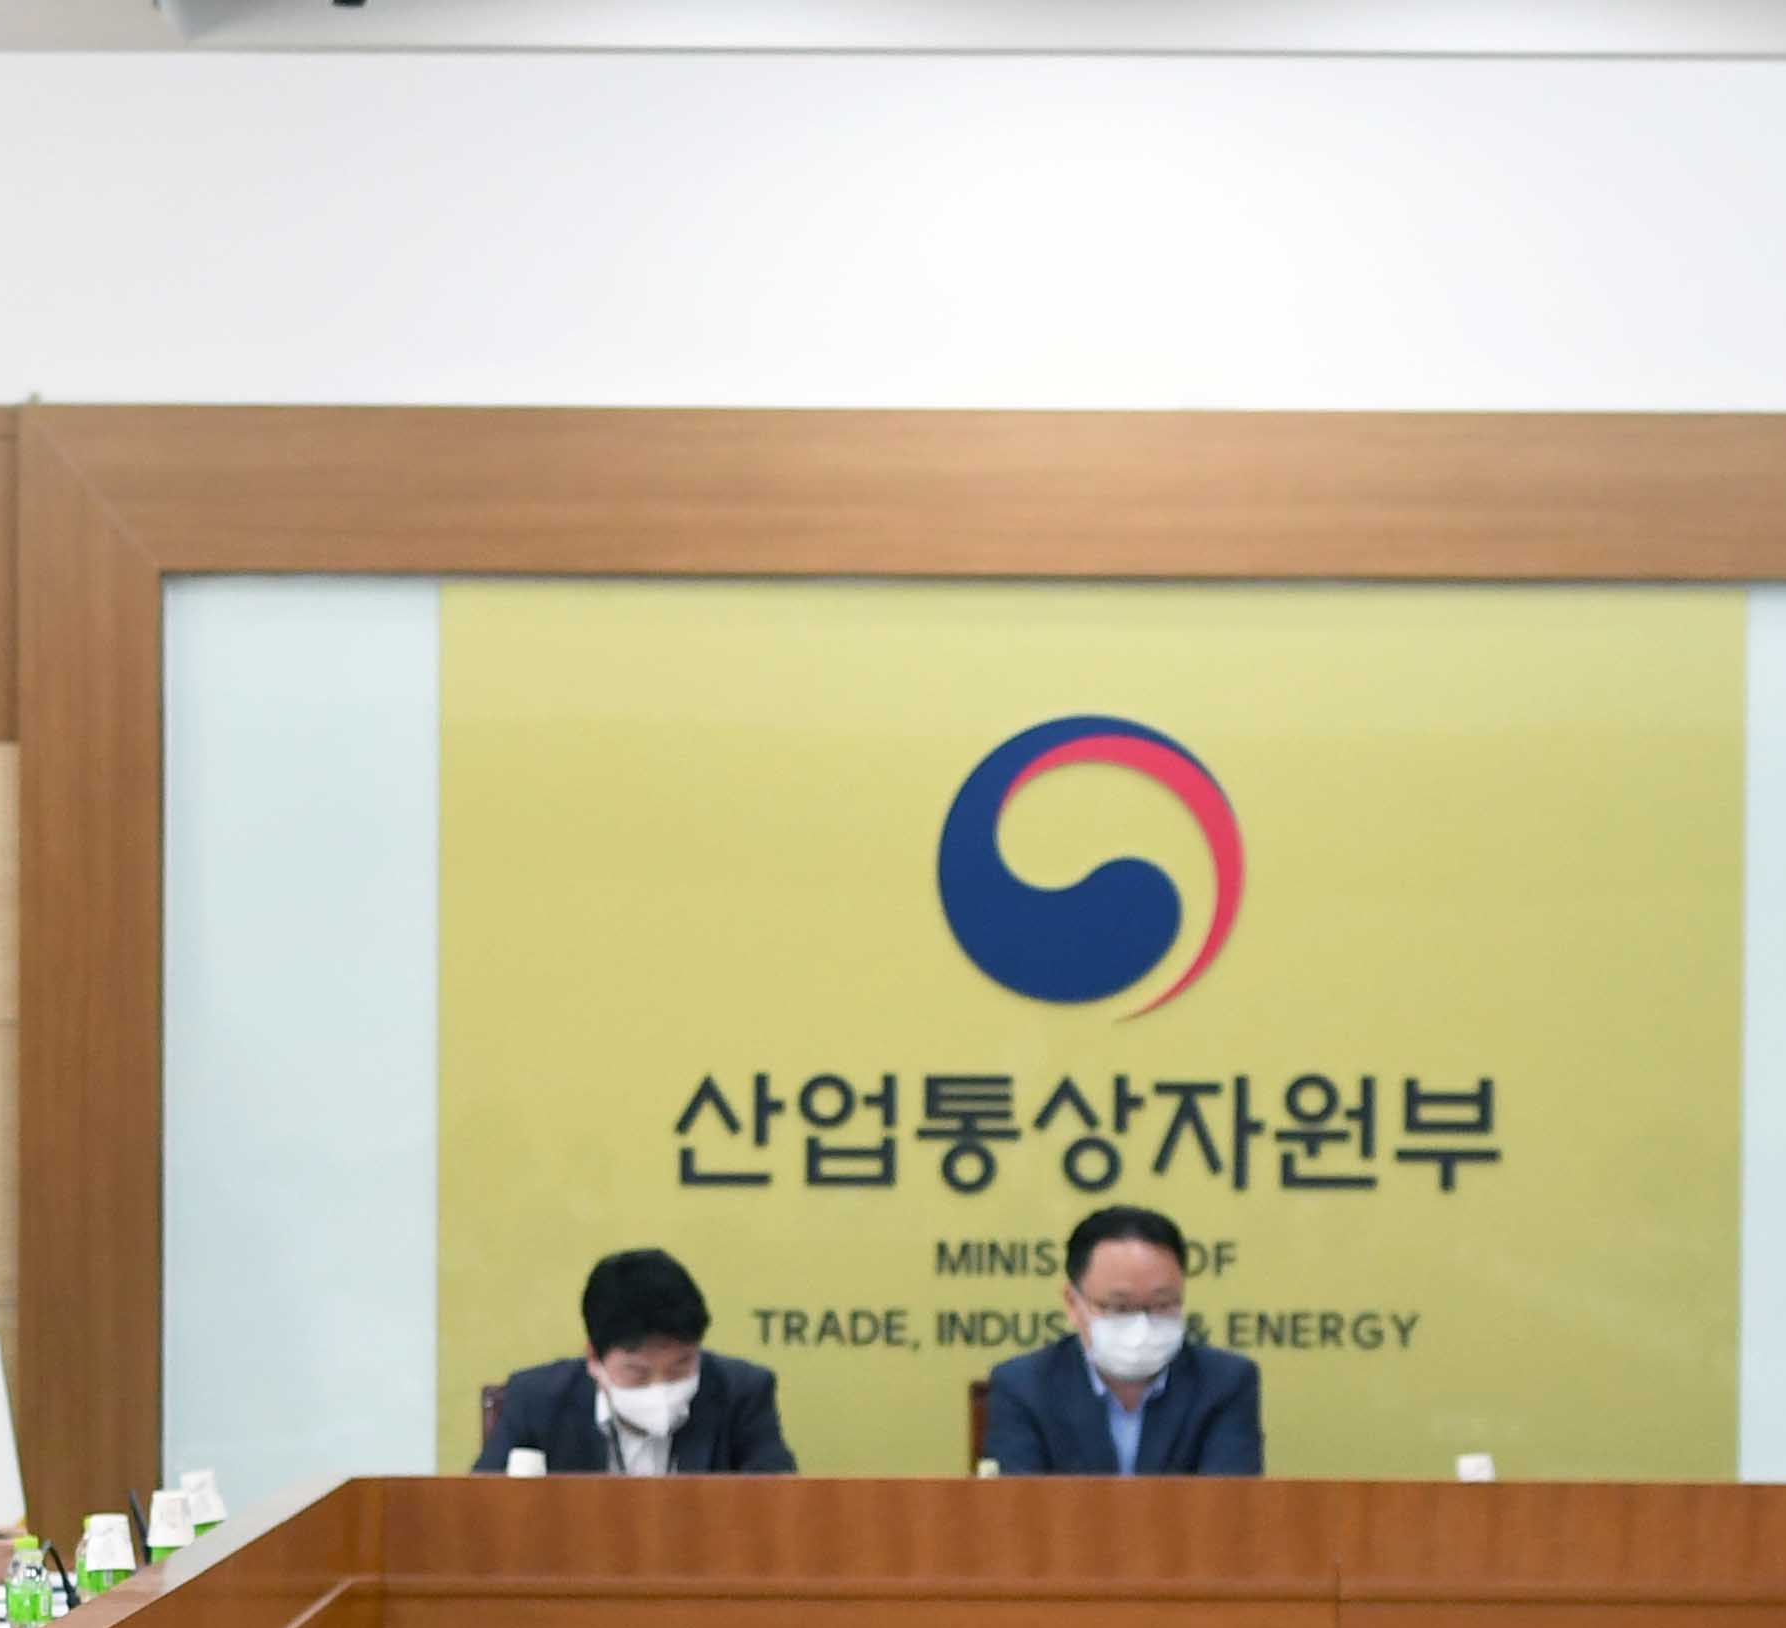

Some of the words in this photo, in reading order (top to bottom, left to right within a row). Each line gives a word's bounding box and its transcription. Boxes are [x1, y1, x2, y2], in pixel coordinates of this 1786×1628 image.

[674, 1072, 1503, 1194] 산업통상자원부
[935, 1238, 1066, 1277] MINIS
[751, 1308, 921, 1351] TRADE,
[935, 1309, 1067, 1348] INDUS
[1226, 1310, 1421, 1350] ENERGY
